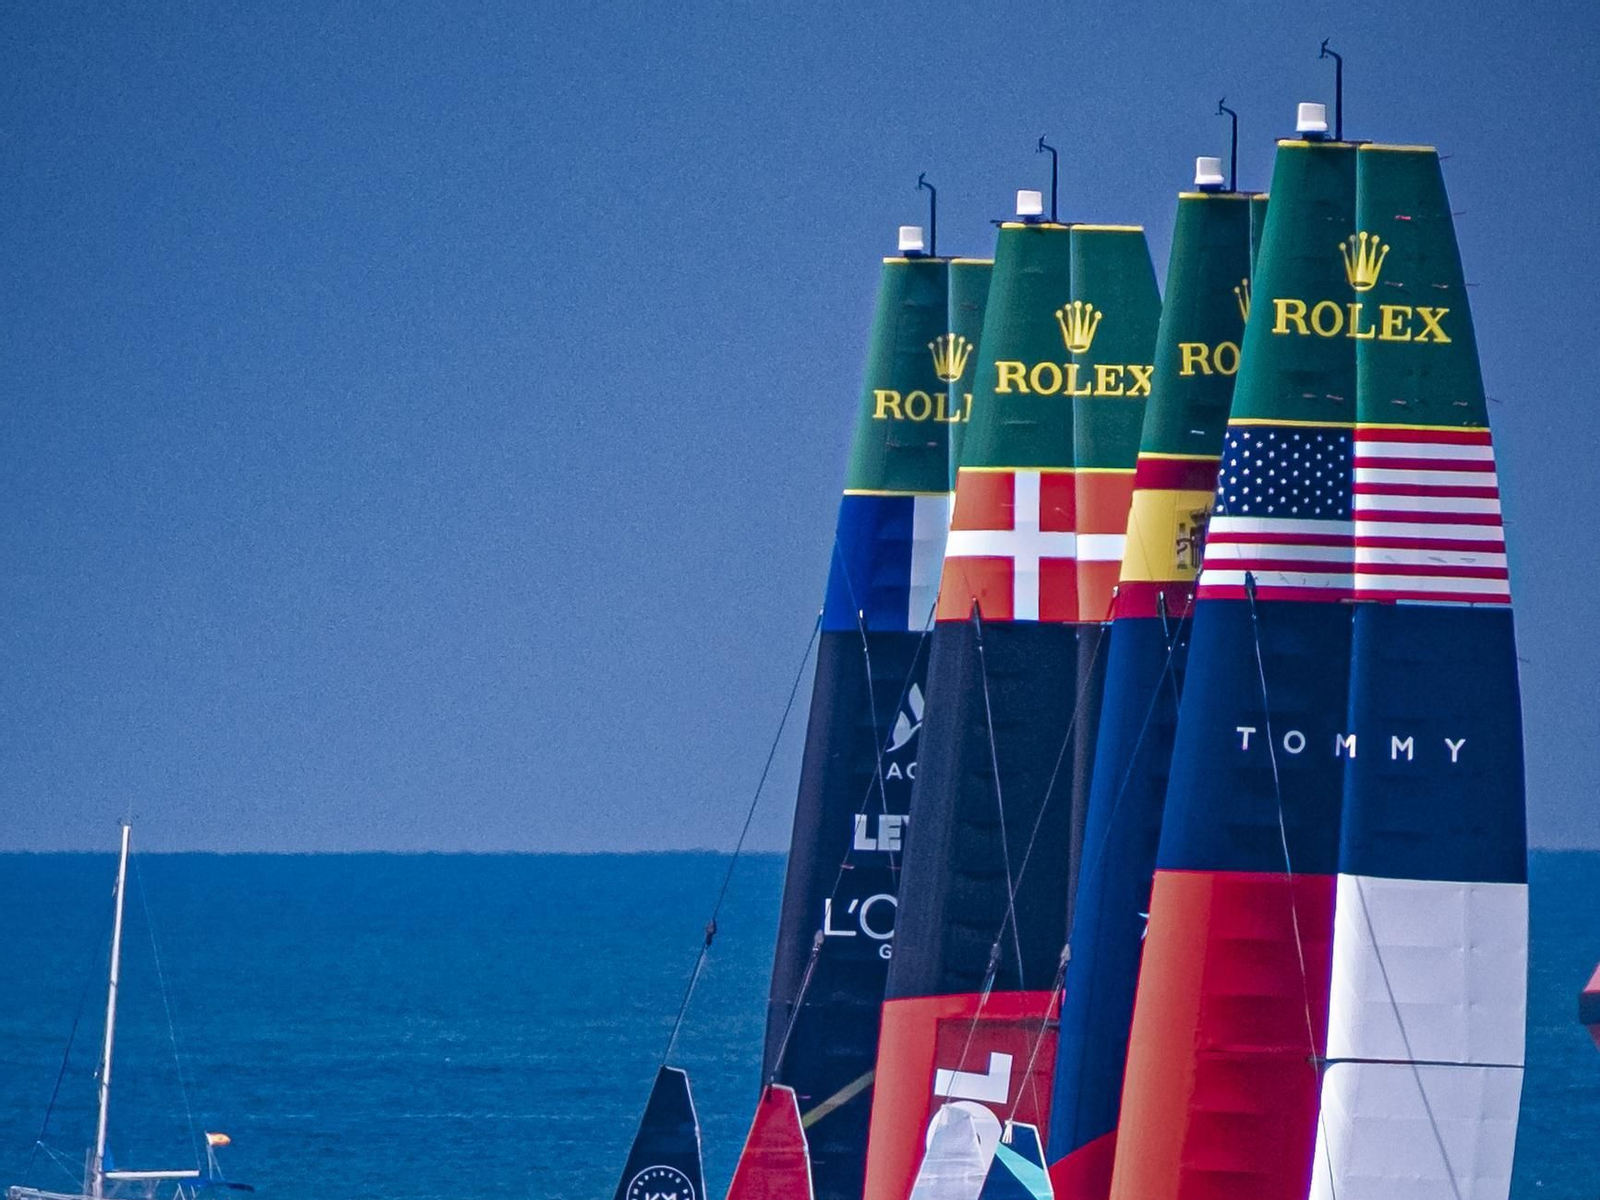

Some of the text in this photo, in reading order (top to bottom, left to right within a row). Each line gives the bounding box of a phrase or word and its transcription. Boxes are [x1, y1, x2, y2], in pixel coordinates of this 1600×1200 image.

[1271, 298, 1452, 344] ROLEX
[994, 360, 1155, 397] ROLEX
[1236, 726, 1467, 763] TOMMY
[854, 813, 909, 851] LE
